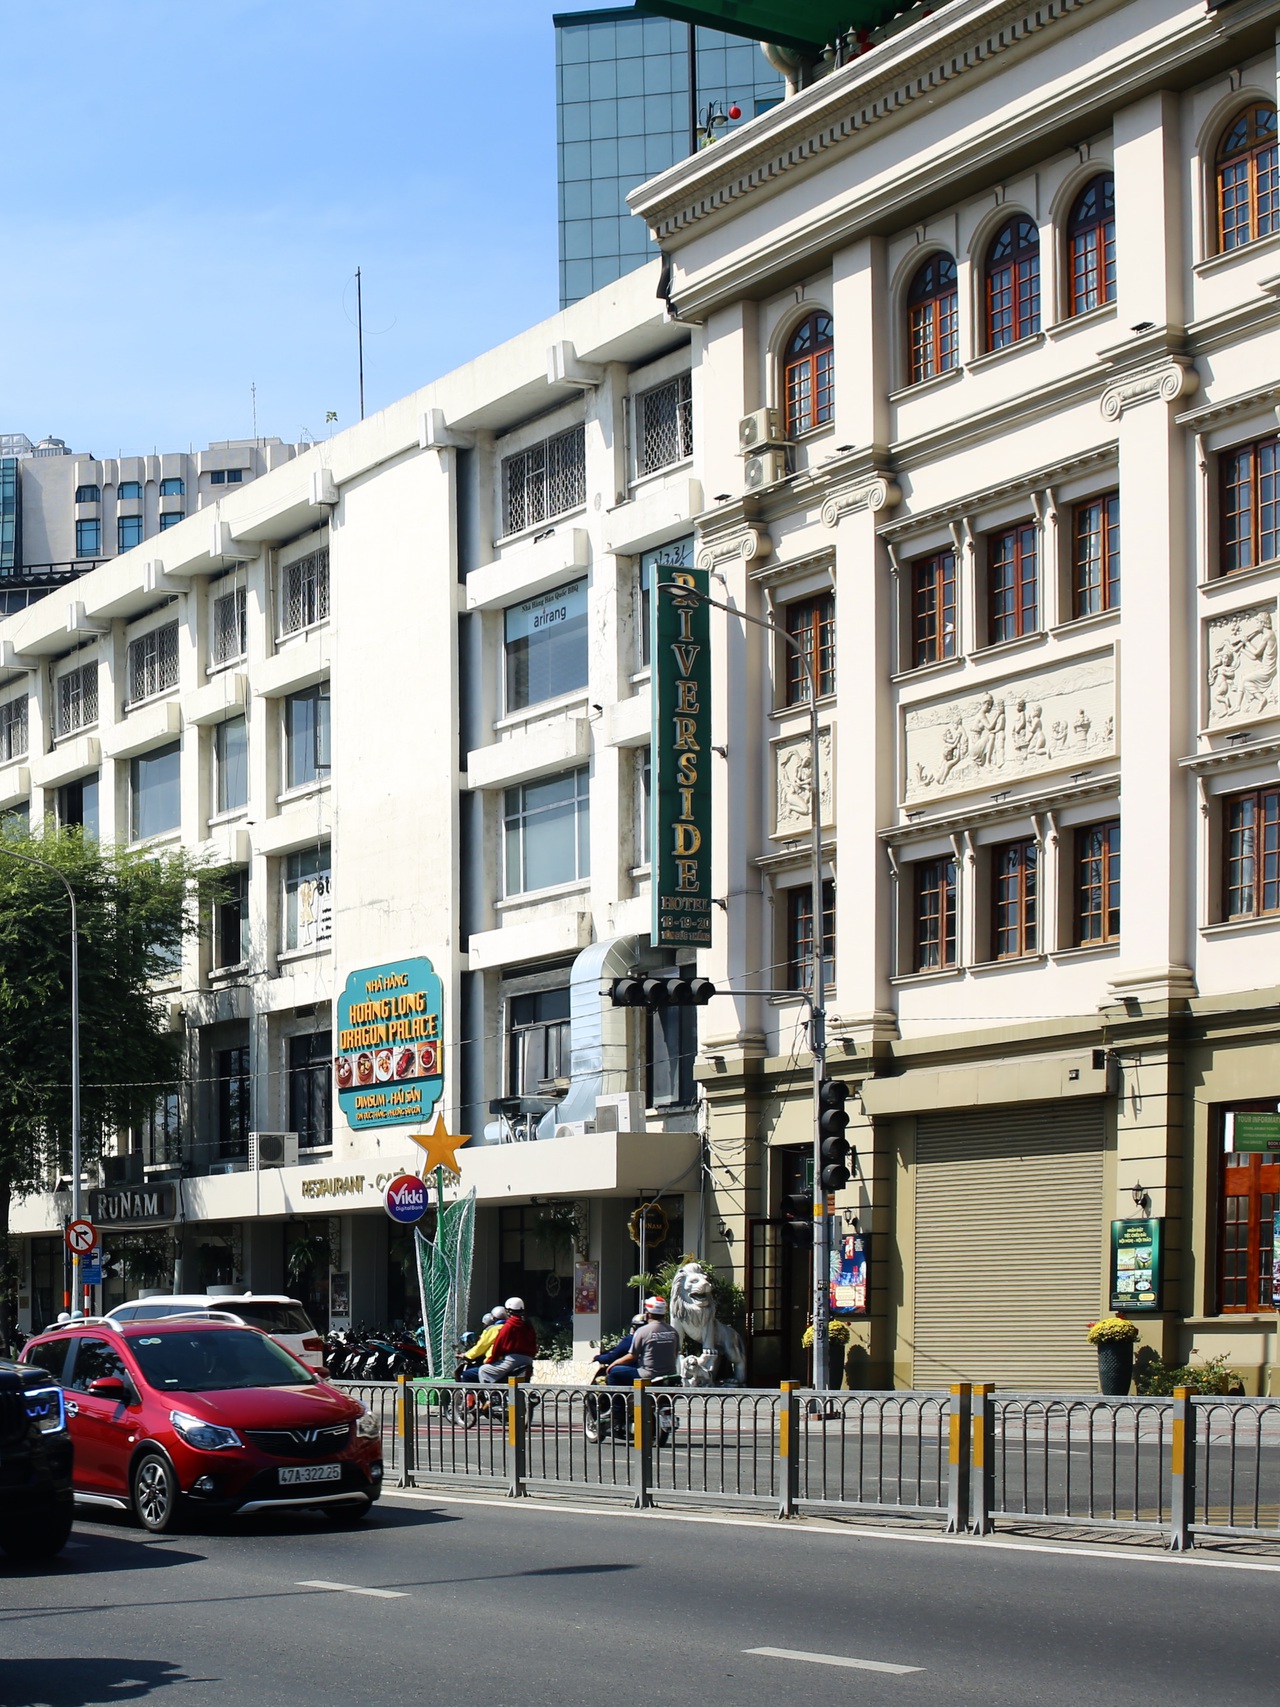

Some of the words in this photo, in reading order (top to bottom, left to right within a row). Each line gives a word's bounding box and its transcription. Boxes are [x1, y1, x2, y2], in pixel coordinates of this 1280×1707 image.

[568, 584, 579, 594] BBQ
[533, 607, 567, 628] arirang
[671, 572, 702, 892] RIVERSIDE
[661, 896, 710, 911] HOTEL
[365, 974, 383, 993] NHÀ
[383, 971, 408, 990] HÀNG
[349, 996, 390, 1024] HOÀNG
[391, 991, 428, 1017] LONG
[339, 1023, 387, 1050] DRAGON
[389, 1014, 437, 1041] PALACE
[355, 1093, 386, 1109] DIMSUM
[301, 1175, 365, 1198] RESTAURANT
[389, 1183, 423, 1205] Vikki
